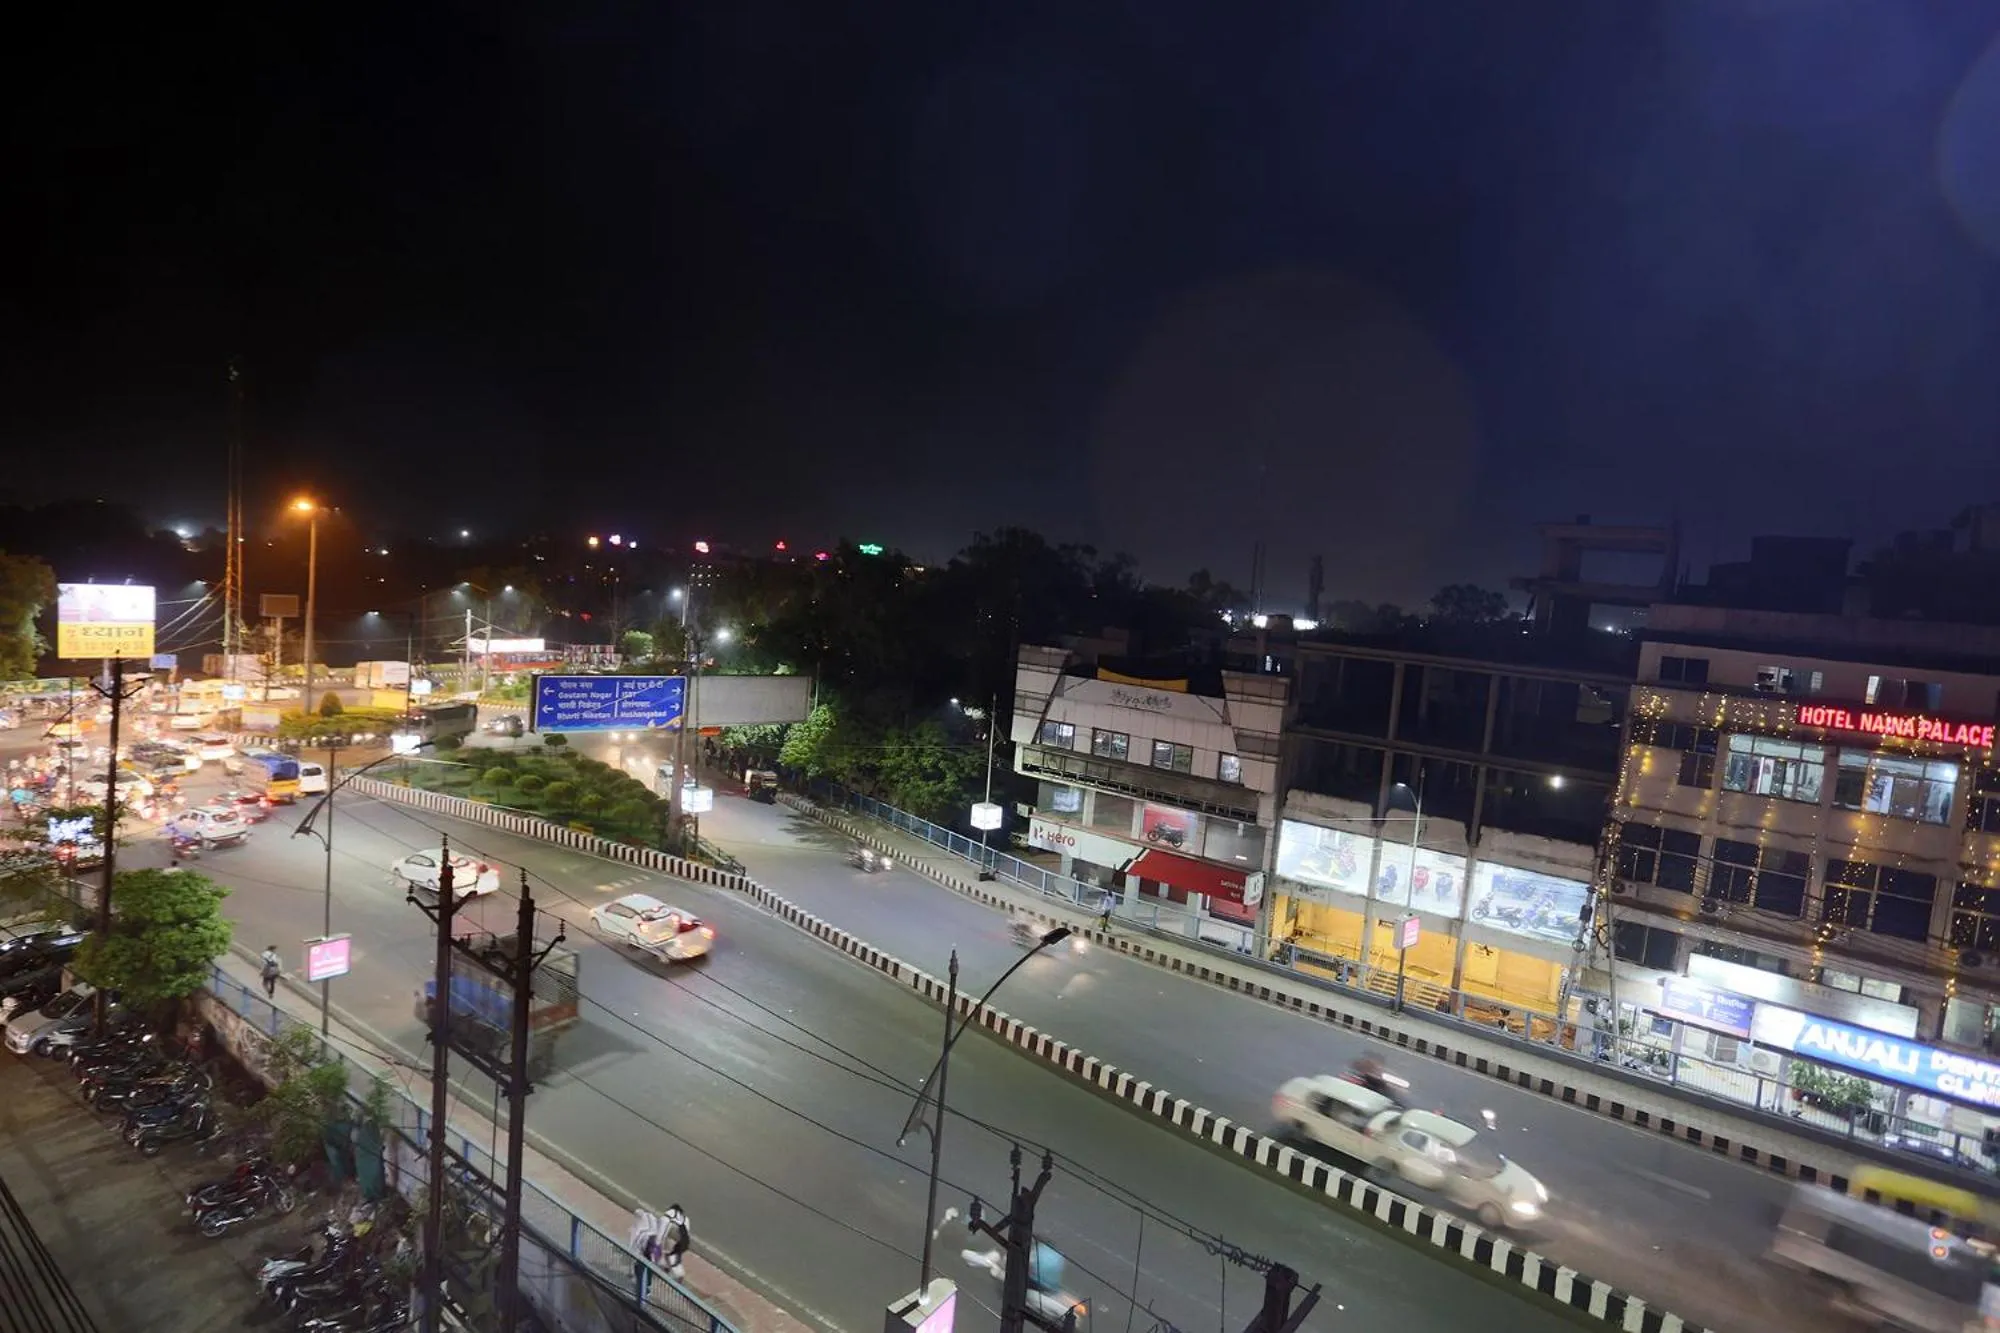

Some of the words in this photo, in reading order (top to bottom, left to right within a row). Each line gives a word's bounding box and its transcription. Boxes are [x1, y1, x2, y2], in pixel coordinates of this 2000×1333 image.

[590, 692, 613, 700] Nagar
[557, 711, 581, 720] Bharti
[582, 711, 611, 719] Niketan
[1800, 706, 1855, 729] HOTEL
[1859, 713, 1915, 737] NAINA
[1918, 720, 1994, 747] PALACE
[1047, 831, 1076, 847] Hero
[1801, 1024, 1920, 1074] ANJALI
